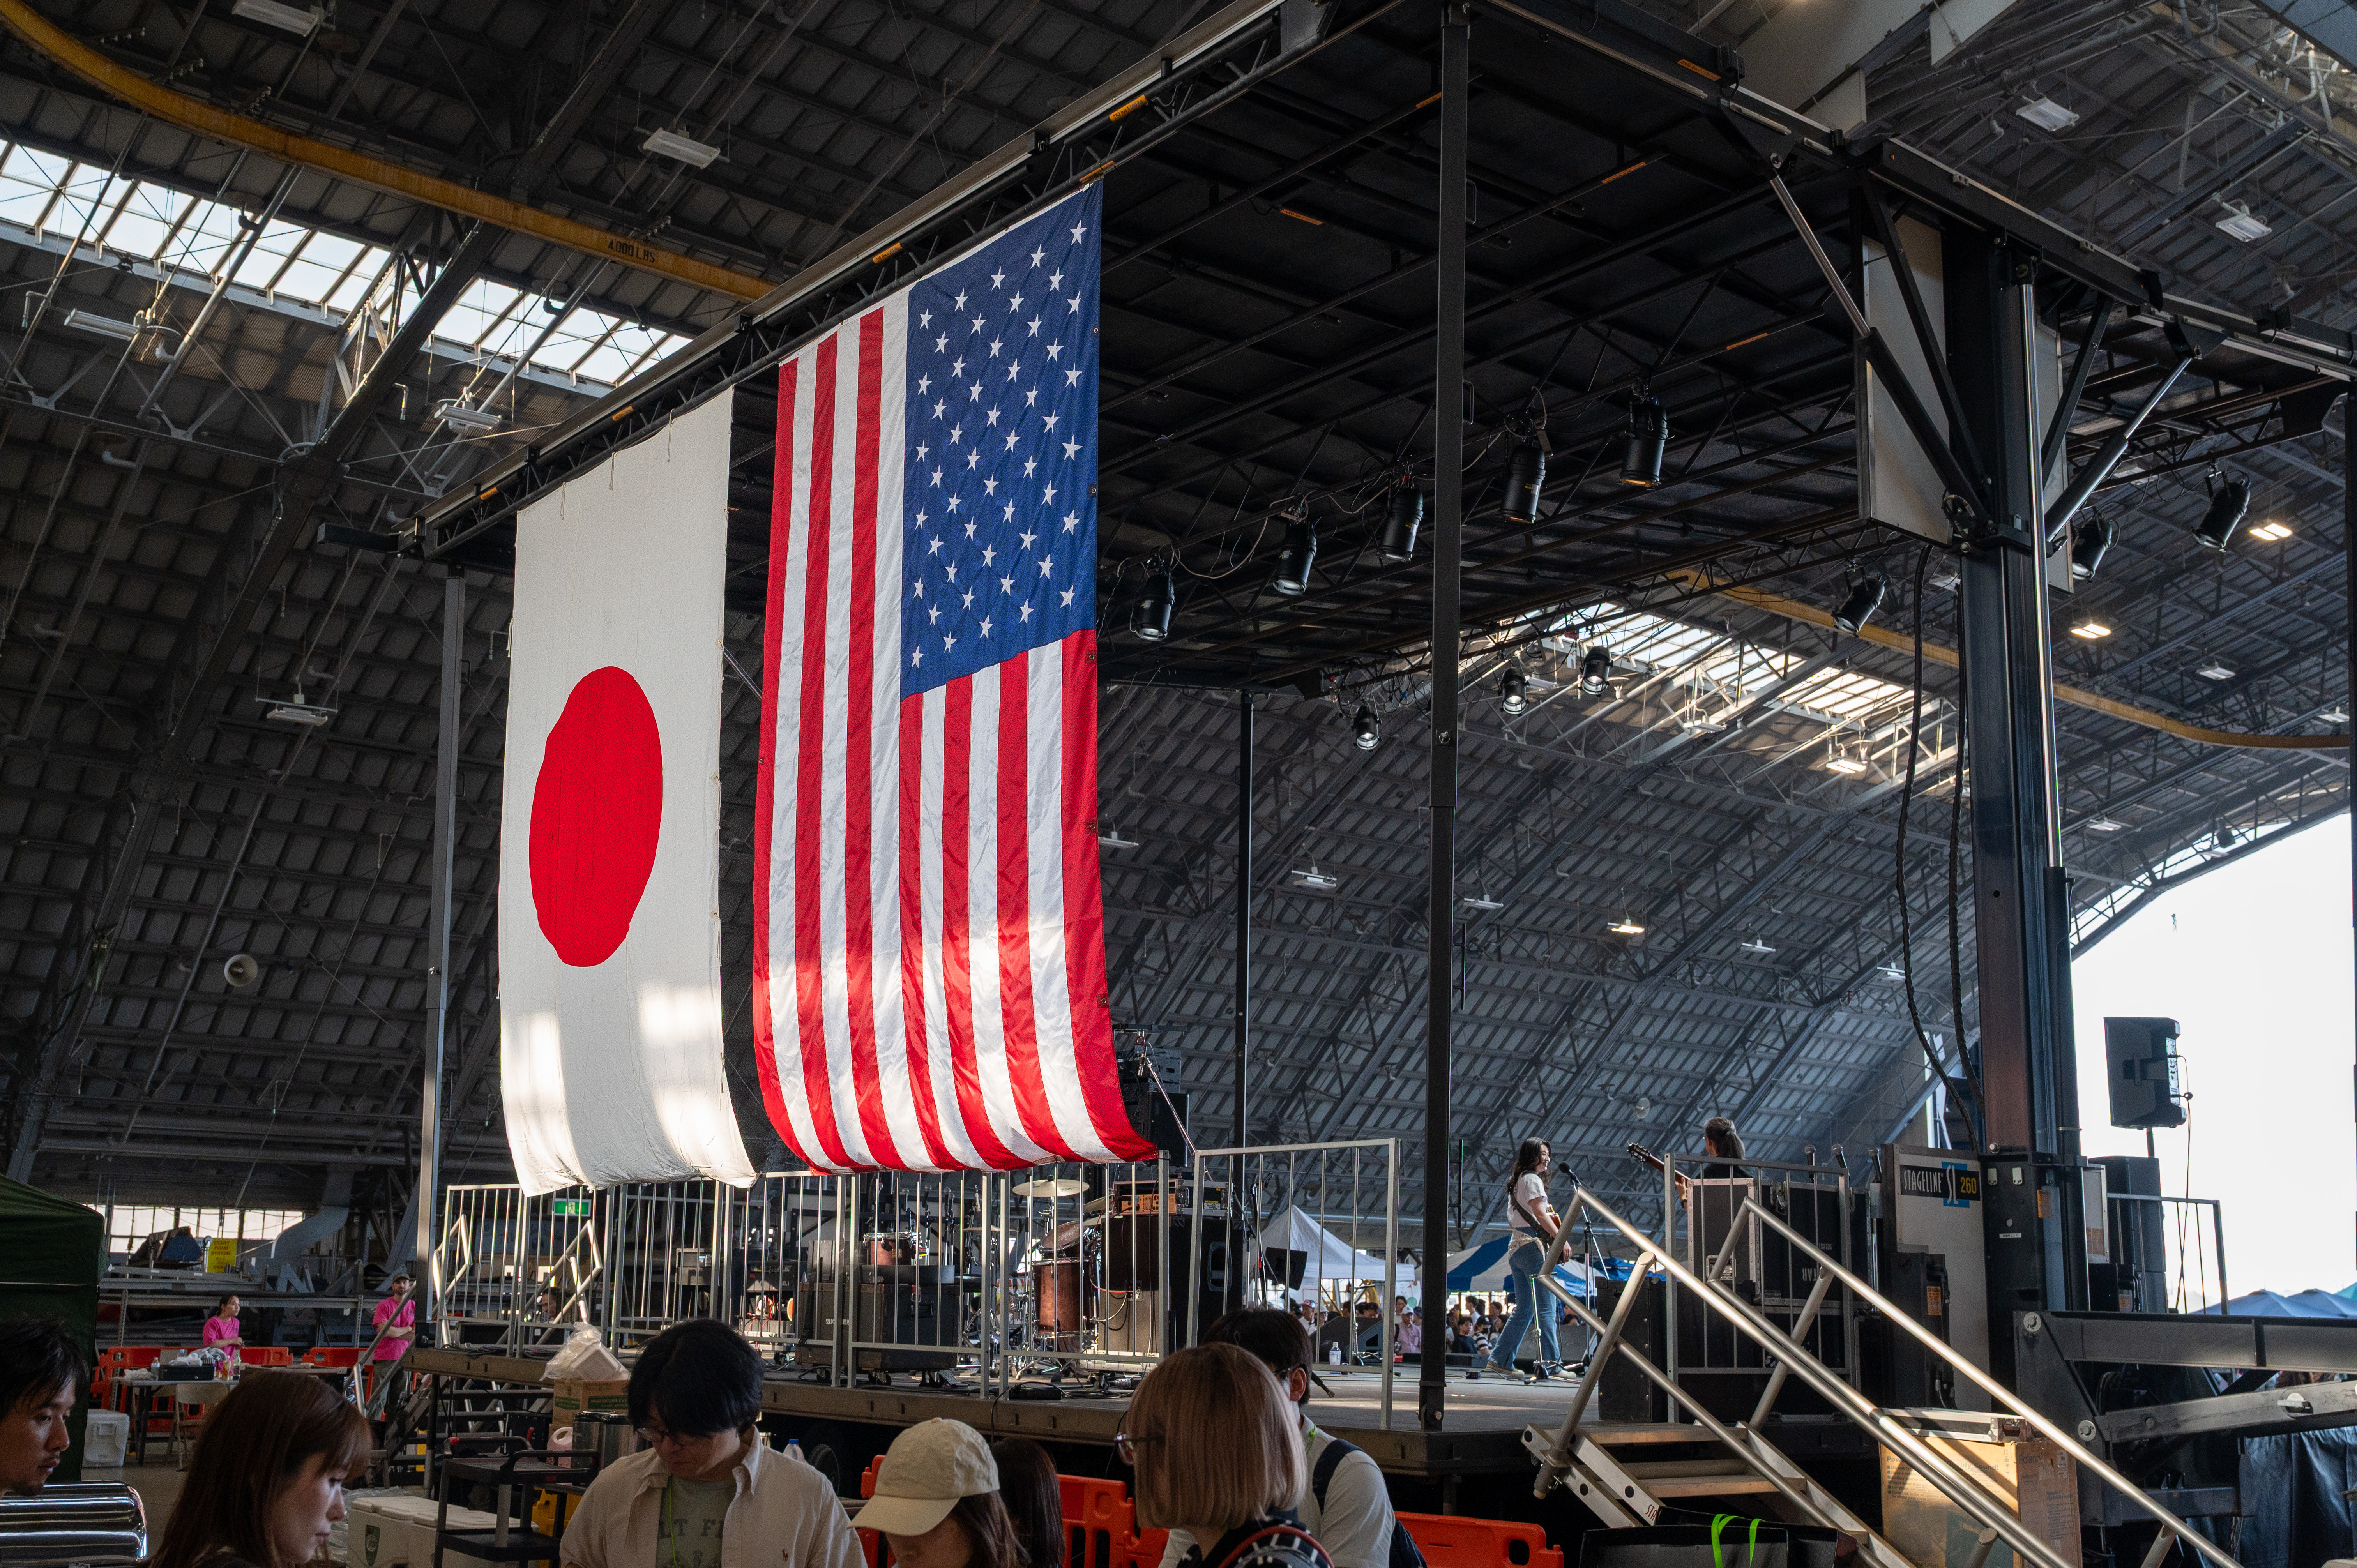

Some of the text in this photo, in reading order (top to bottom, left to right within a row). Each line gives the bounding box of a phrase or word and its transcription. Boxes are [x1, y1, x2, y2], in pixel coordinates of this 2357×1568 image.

[608, 239, 656, 263] 4000 LBS
[1960, 1176, 1977, 1194] 260
[1802, 1268, 1818, 1282] TAR
[1974, 1462, 1999, 1471] Sound!
[1645, 1504, 1658, 1521] STA
[658, 1518, 689, 1540] LT
